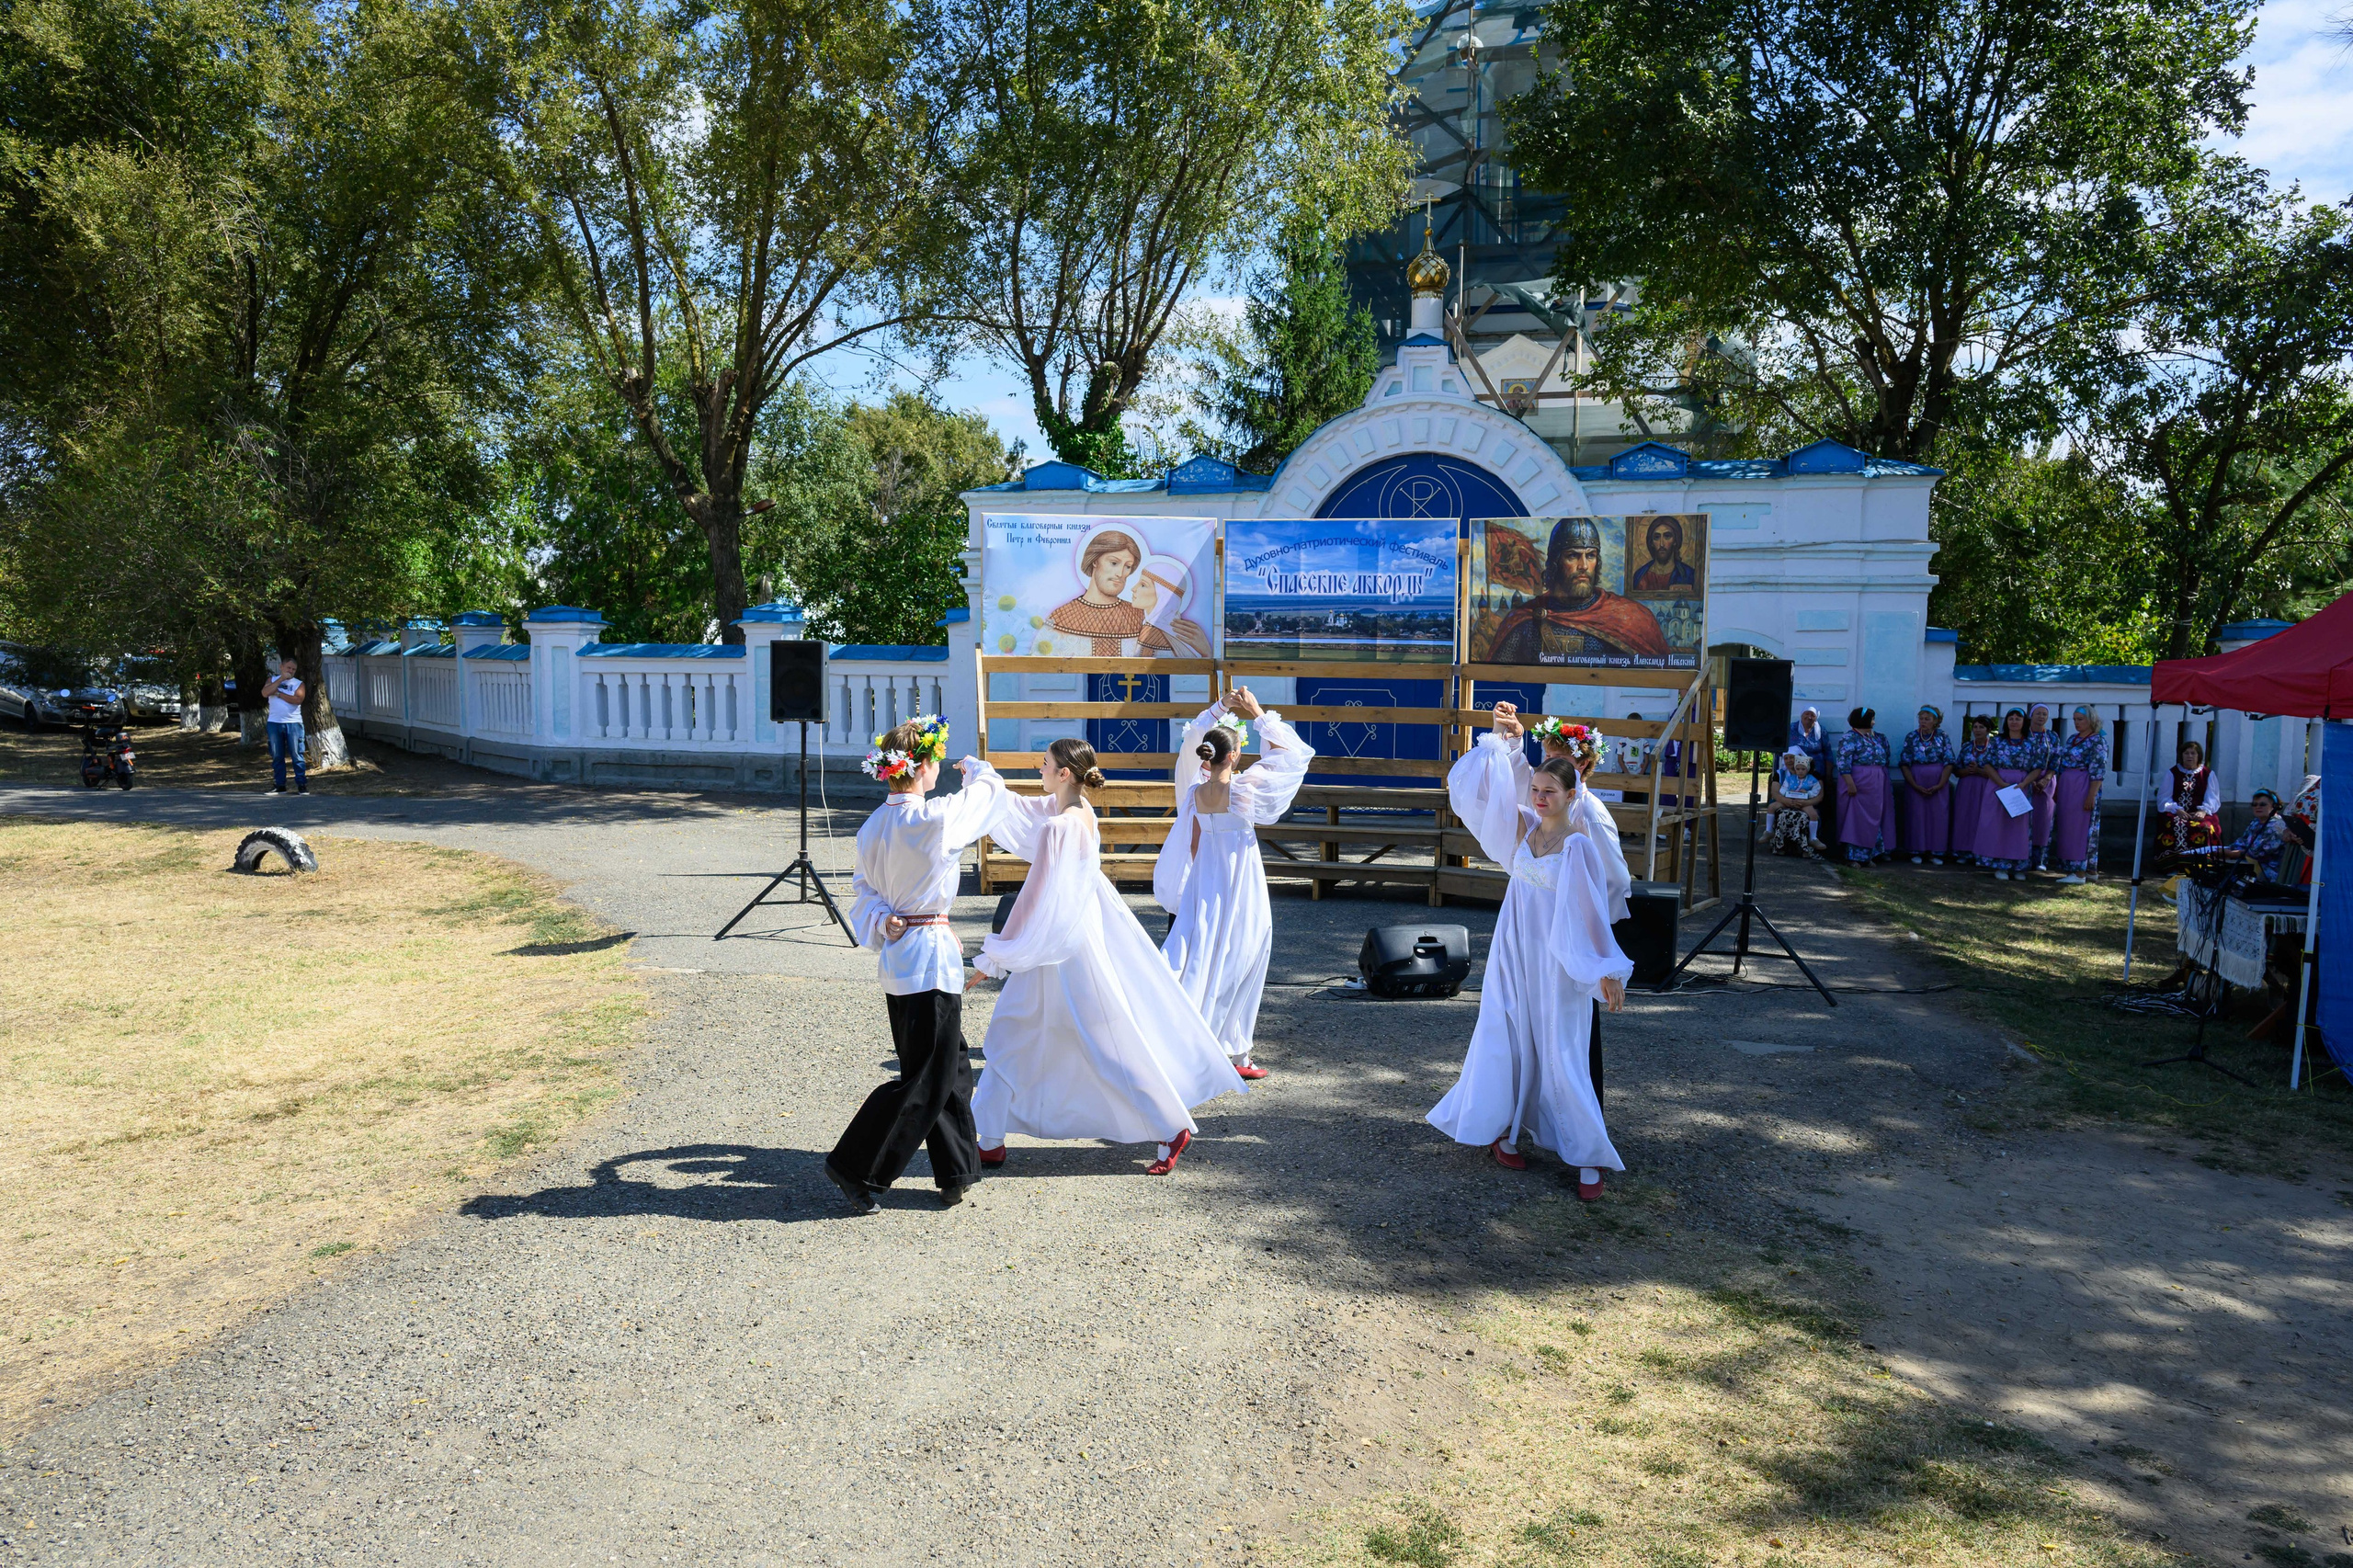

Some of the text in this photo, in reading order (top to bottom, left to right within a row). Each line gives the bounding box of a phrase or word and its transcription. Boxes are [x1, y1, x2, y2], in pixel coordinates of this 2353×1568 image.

[987, 518, 1017, 528] Святые
[1021, 523, 1063, 533] благоверные
[1007, 533, 1023, 548] Петр
[1036, 534, 1071, 548] Феброния
[1244, 537, 1449, 572] Духовно-патриотический фестиваль
[1258, 565, 1433, 602] "Спасские аккорды"
[1540, 652, 1696, 669] Святой благоверный князь Александр Невский
